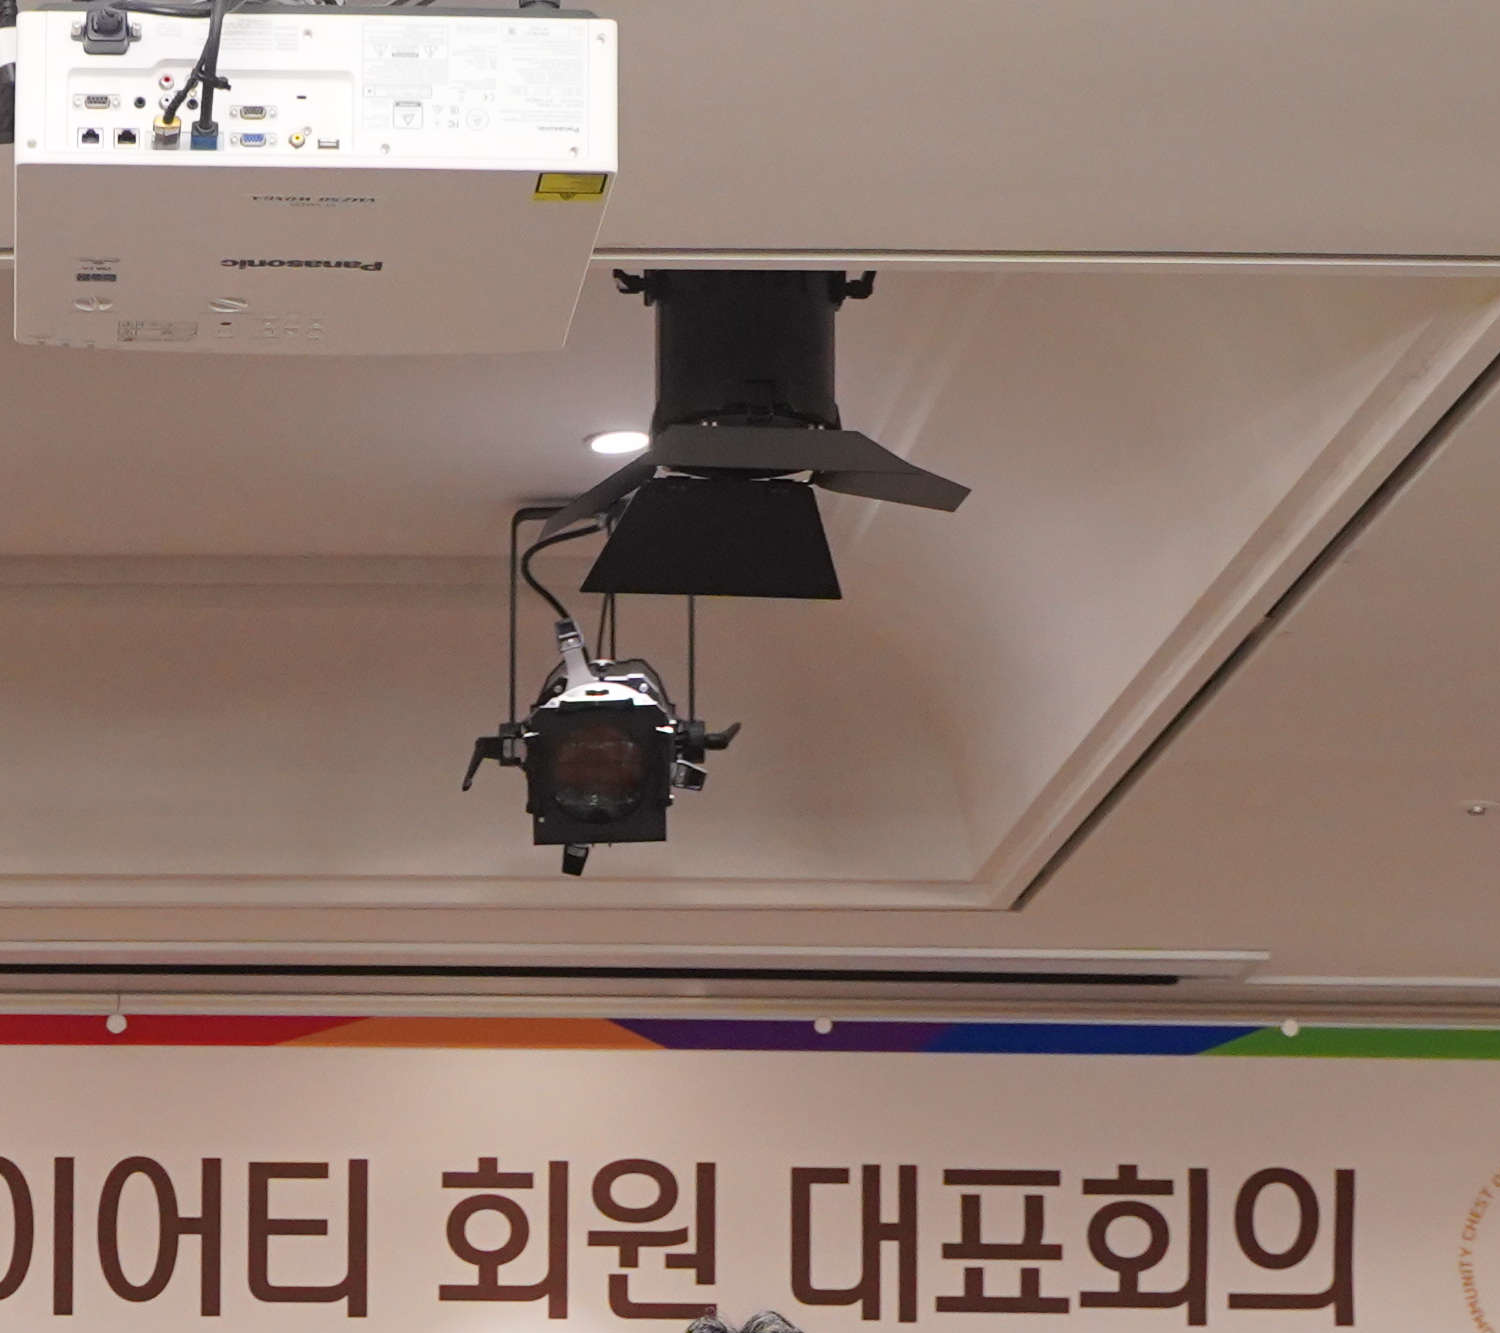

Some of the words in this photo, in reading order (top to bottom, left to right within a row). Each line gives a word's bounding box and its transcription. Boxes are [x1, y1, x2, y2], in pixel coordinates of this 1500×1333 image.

[220, 257, 383, 274] Panasonic
[1462, 1188, 1494, 1241] CHEST
[438, 1157, 717, 1320] 회원
[790, 1163, 1356, 1327] 대표회의
